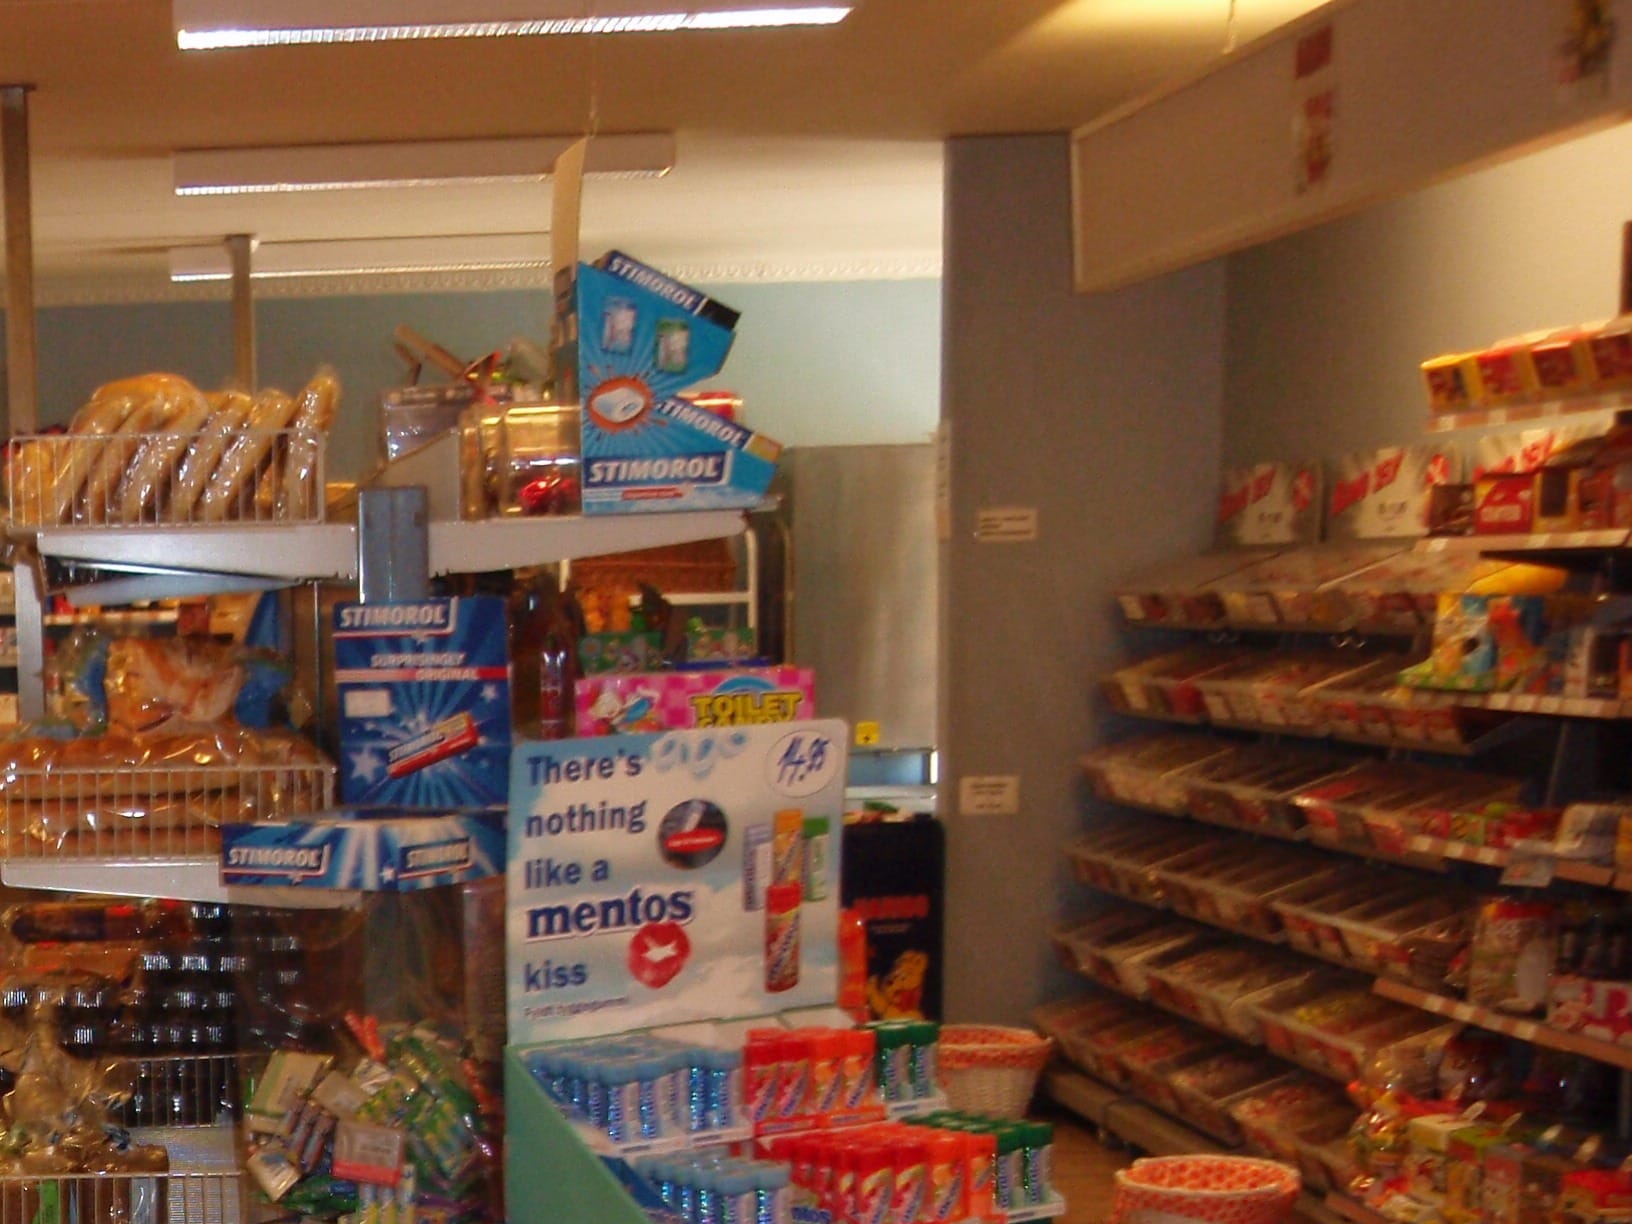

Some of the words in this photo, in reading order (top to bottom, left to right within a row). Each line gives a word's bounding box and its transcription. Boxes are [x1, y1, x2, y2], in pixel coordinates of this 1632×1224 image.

[607, 256, 697, 313] STIMOROL
[656, 398, 747, 447] TIMOROL
[589, 453, 719, 484] STIMOROL
[339, 603, 446, 629] STIMOROL
[691, 692, 802, 722] TOILET
[527, 749, 642, 787] There's
[525, 800, 649, 838] nothing
[228, 846, 320, 869] STIMOROL
[524, 858, 582, 890] like
[591, 858, 610, 882] a
[527, 887, 697, 938] mentos
[525, 959, 588, 993] kiss
